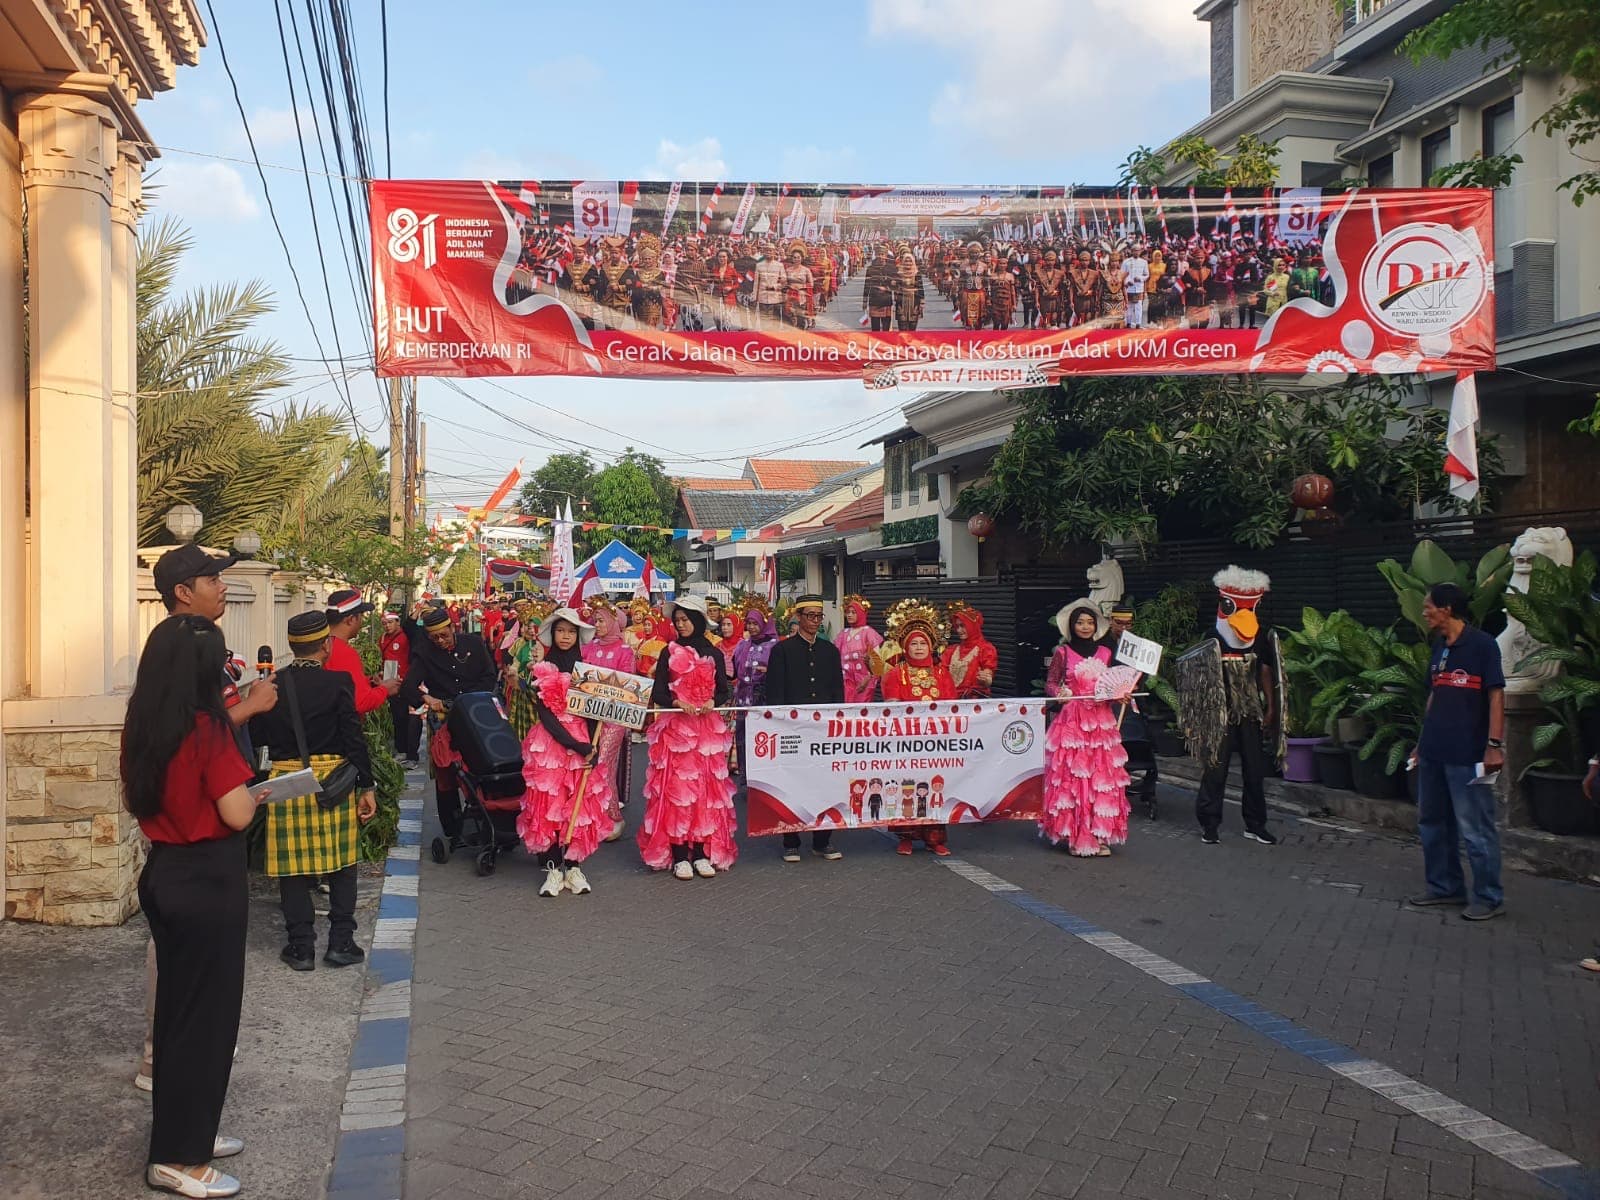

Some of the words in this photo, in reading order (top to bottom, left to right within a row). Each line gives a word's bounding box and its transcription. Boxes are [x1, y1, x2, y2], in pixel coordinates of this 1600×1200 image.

[445, 219, 489, 227] INDONESIA
[582, 198, 609, 227] 81
[1288, 204, 1313, 231] 81
[387, 208, 440, 270] 81
[446, 240, 464, 248] ADIL
[467, 240, 484, 248] DAN
[395, 306, 448, 333] HUT
[396, 341, 511, 359] KEMERDEKAAN
[517, 343, 531, 359] RI
[606, 340, 673, 361] Gerak
[679, 341, 737, 361] Jalan
[743, 339, 839, 362] Gembira
[846, 340, 861, 361] &
[868, 339, 961, 360] Karnaval
[969, 340, 1052, 360] Kostum
[1059, 338, 1111, 358] Adat
[1117, 339, 1167, 358] UKM
[1173, 338, 1237, 358] Green
[900, 369, 952, 383] START
[956, 368, 963, 383] /
[968, 368, 1022, 381] FINISH
[1119, 639, 1156, 665] RT.10
[569, 696, 581, 710] 01
[584, 698, 643, 725] SULAWESI
[827, 715, 970, 738] DIRGAHAYU
[754, 731, 778, 760] 81
[809, 741, 892, 756] REPUBLIK
[896, 738, 984, 753] INDONESIA
[831, 761, 848, 772] RT
[852, 760, 867, 771] 10
[871, 759, 892, 771] RW
[895, 759, 906, 770] IX
[910, 757, 964, 769] REWWIN
